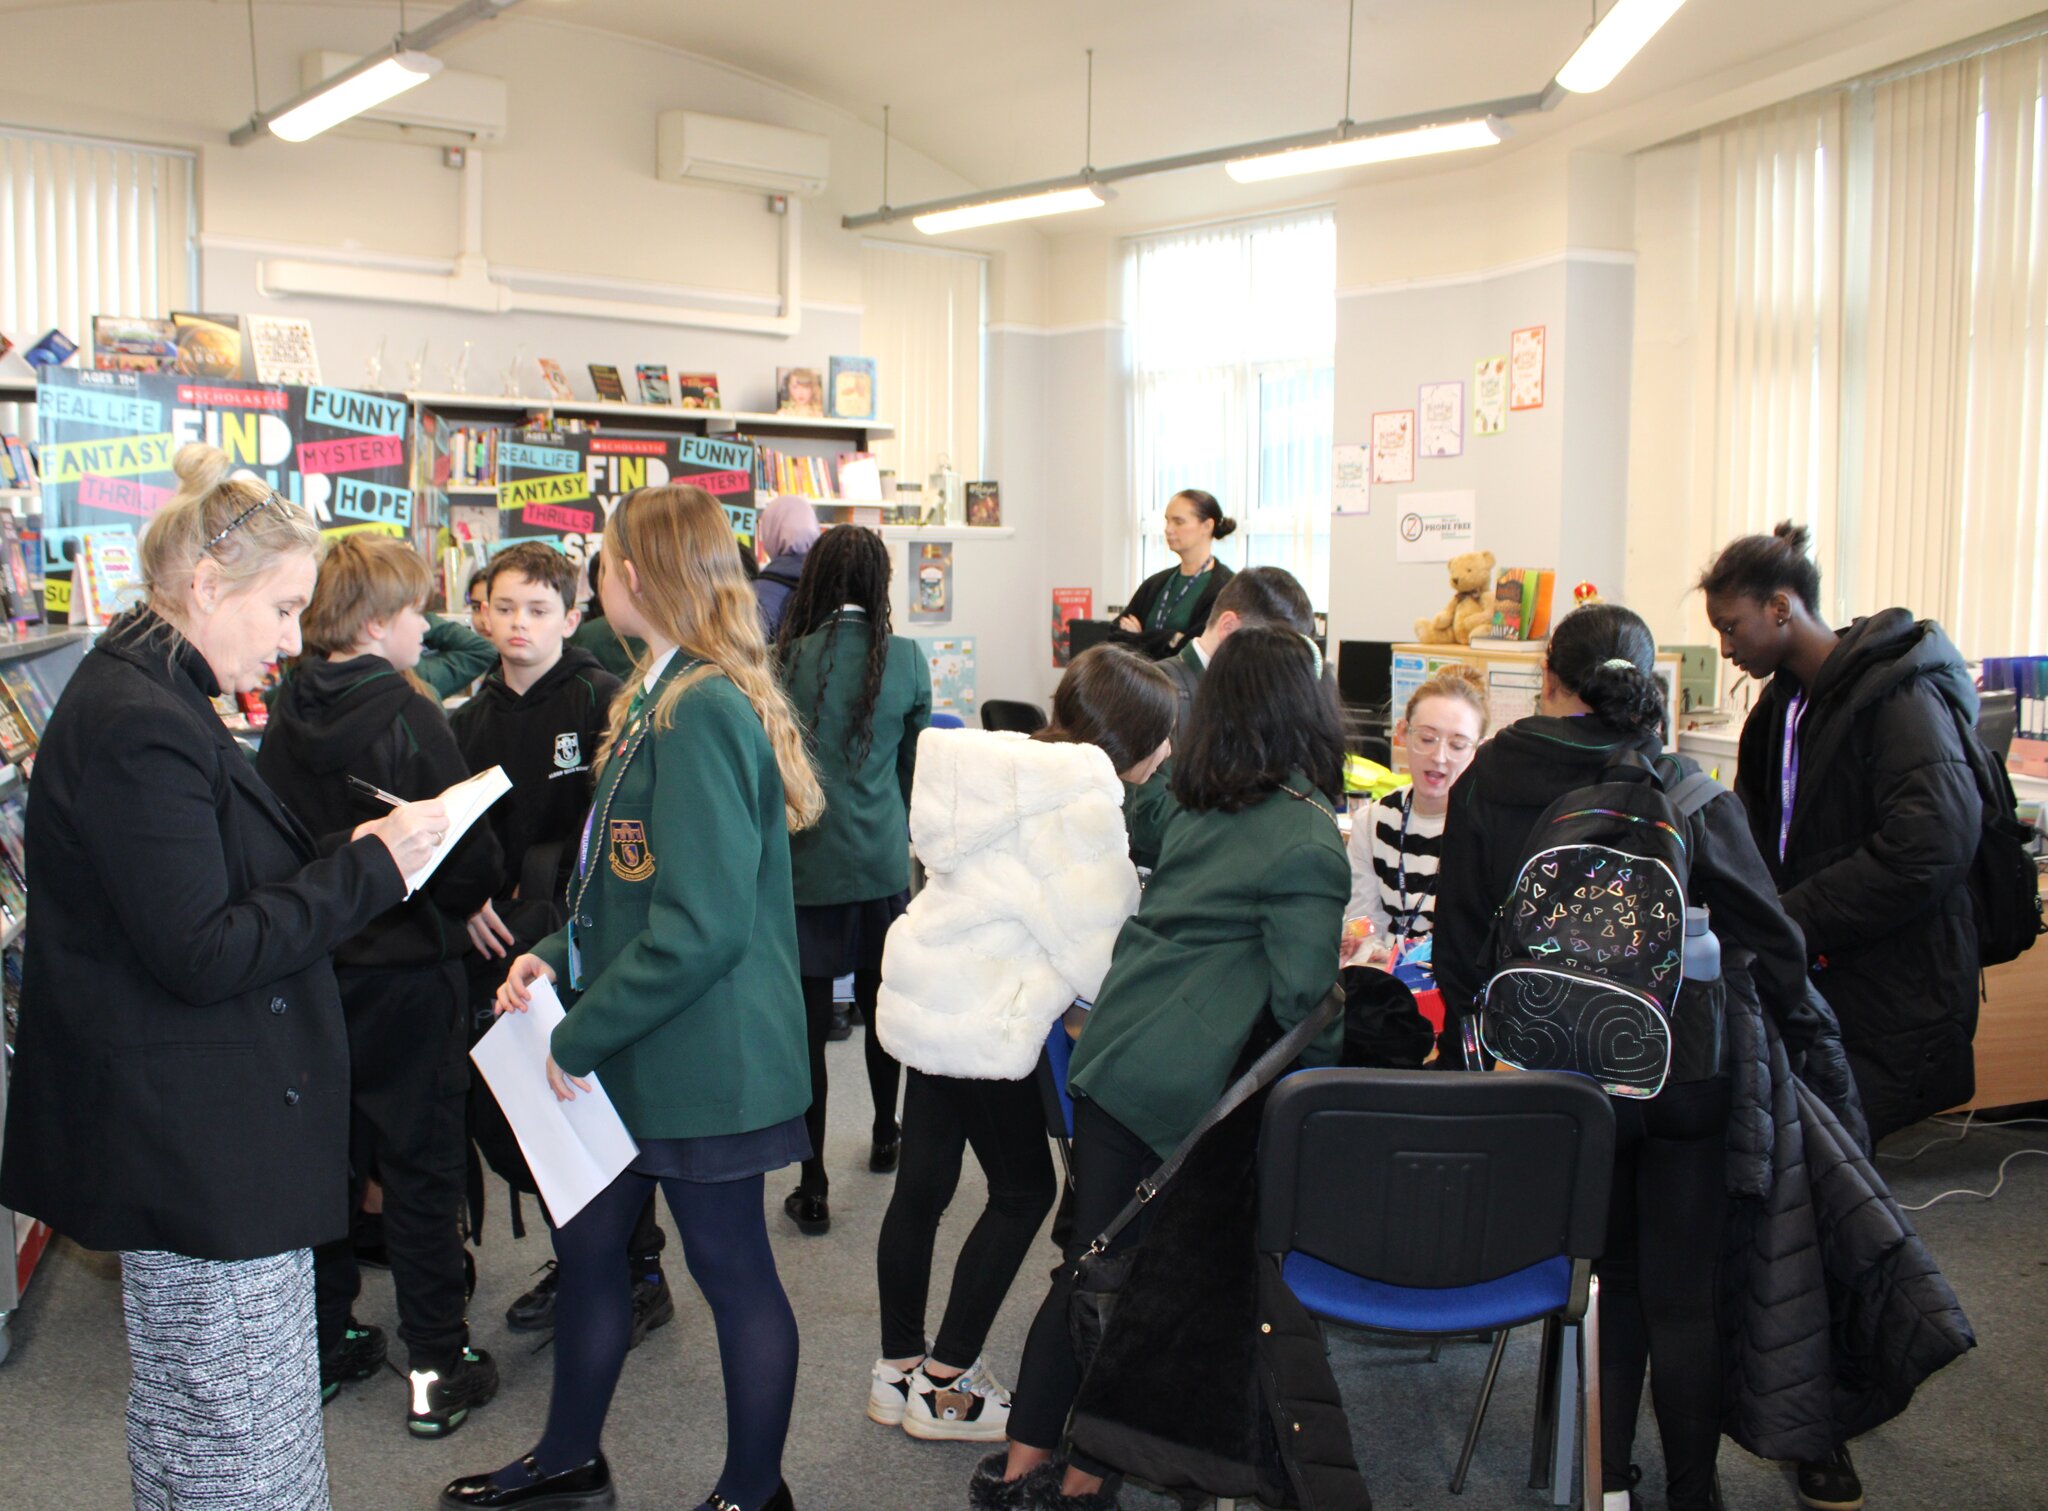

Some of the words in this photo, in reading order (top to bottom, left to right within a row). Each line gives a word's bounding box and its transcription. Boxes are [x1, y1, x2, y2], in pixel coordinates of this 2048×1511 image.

[81, 372, 113, 384] AGES
[39, 391, 98, 420] REAL
[107, 403, 155, 427] LIFE
[193, 391, 285, 409] SCHOLASTIC
[312, 390, 401, 432] FUNNY
[172, 408, 293, 466] FIND
[43, 439, 168, 476] FANTASY
[303, 439, 398, 467] MYSTERY
[500, 446, 537, 465] REAL
[543, 453, 575, 469] LIFE
[683, 440, 749, 467] FUNNY
[586, 455, 670, 493] FIND
[340, 483, 408, 520] HOPE
[500, 476, 584, 503] FANTASY
[527, 503, 591, 530] THRILLS
[1782, 739, 1792, 768] STUDENT
[1782, 779, 1790, 808] STUDENT
